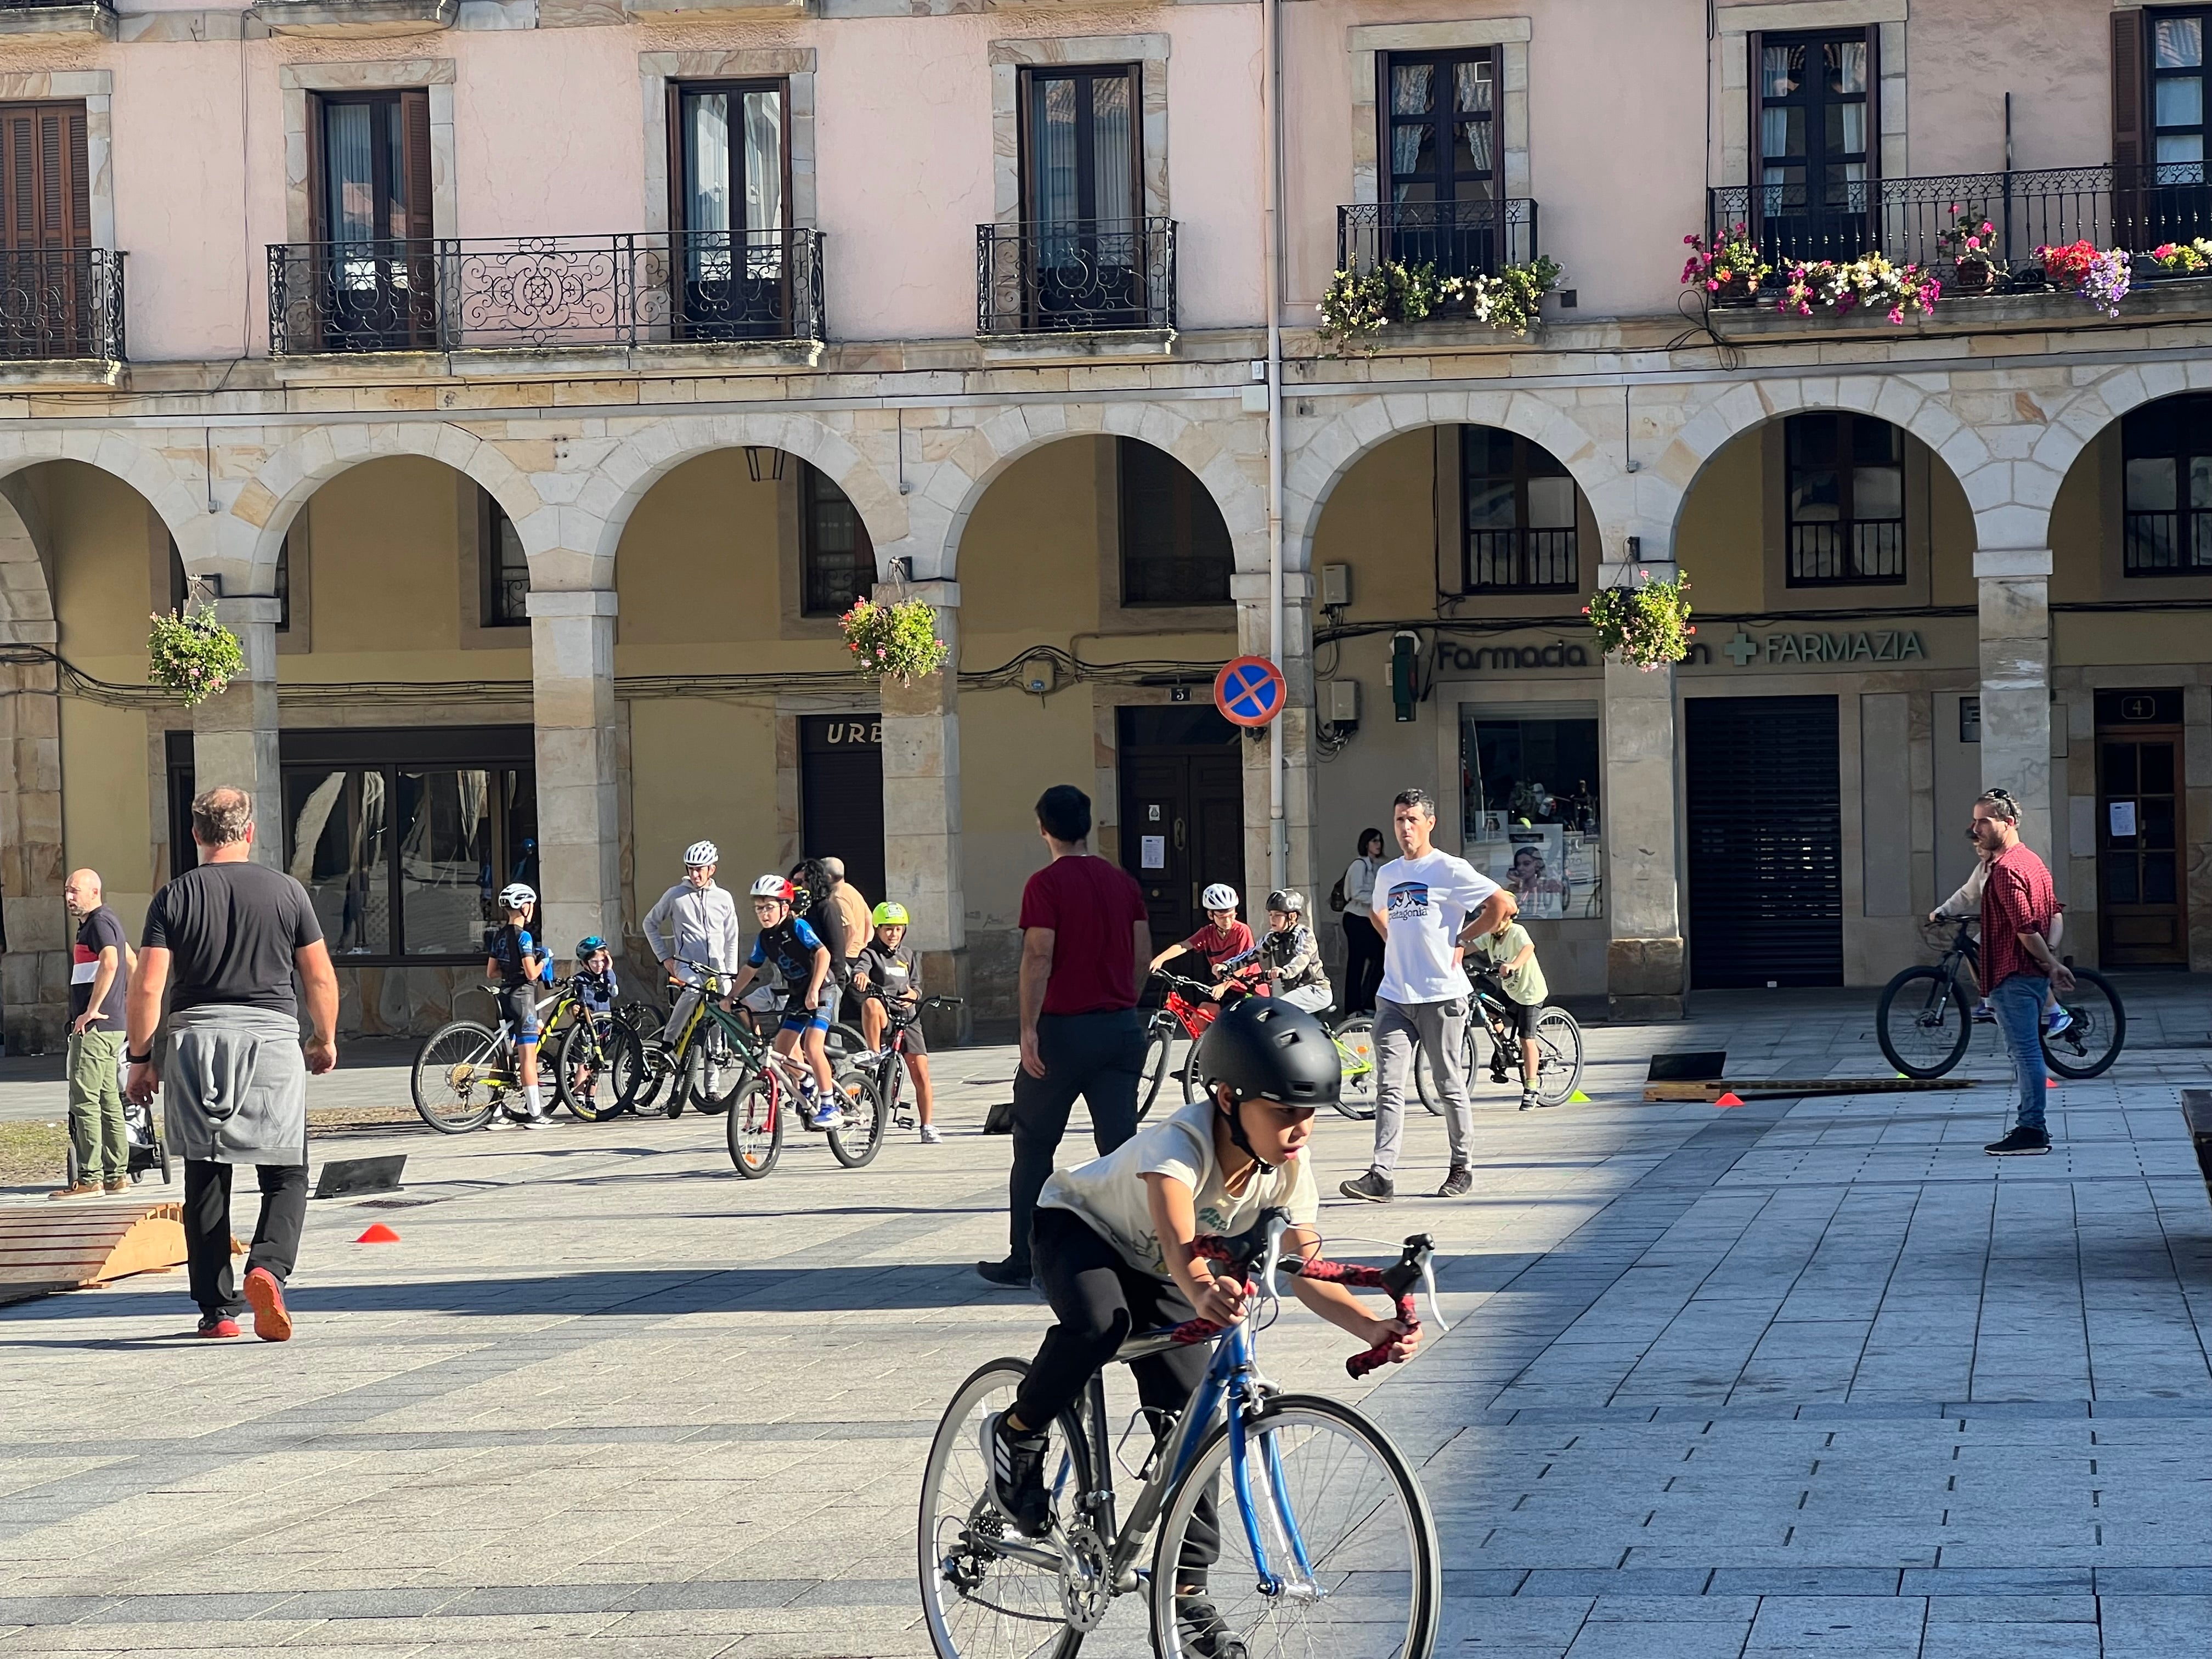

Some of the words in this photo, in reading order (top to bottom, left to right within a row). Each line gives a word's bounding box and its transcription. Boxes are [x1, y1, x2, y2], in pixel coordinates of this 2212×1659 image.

[1437, 639, 1587, 670] Farmacia
[1765, 631, 1924, 663] FARMAZIA
[2132, 699, 2142, 715] 4
[1388, 907, 1428, 923] patagonia
